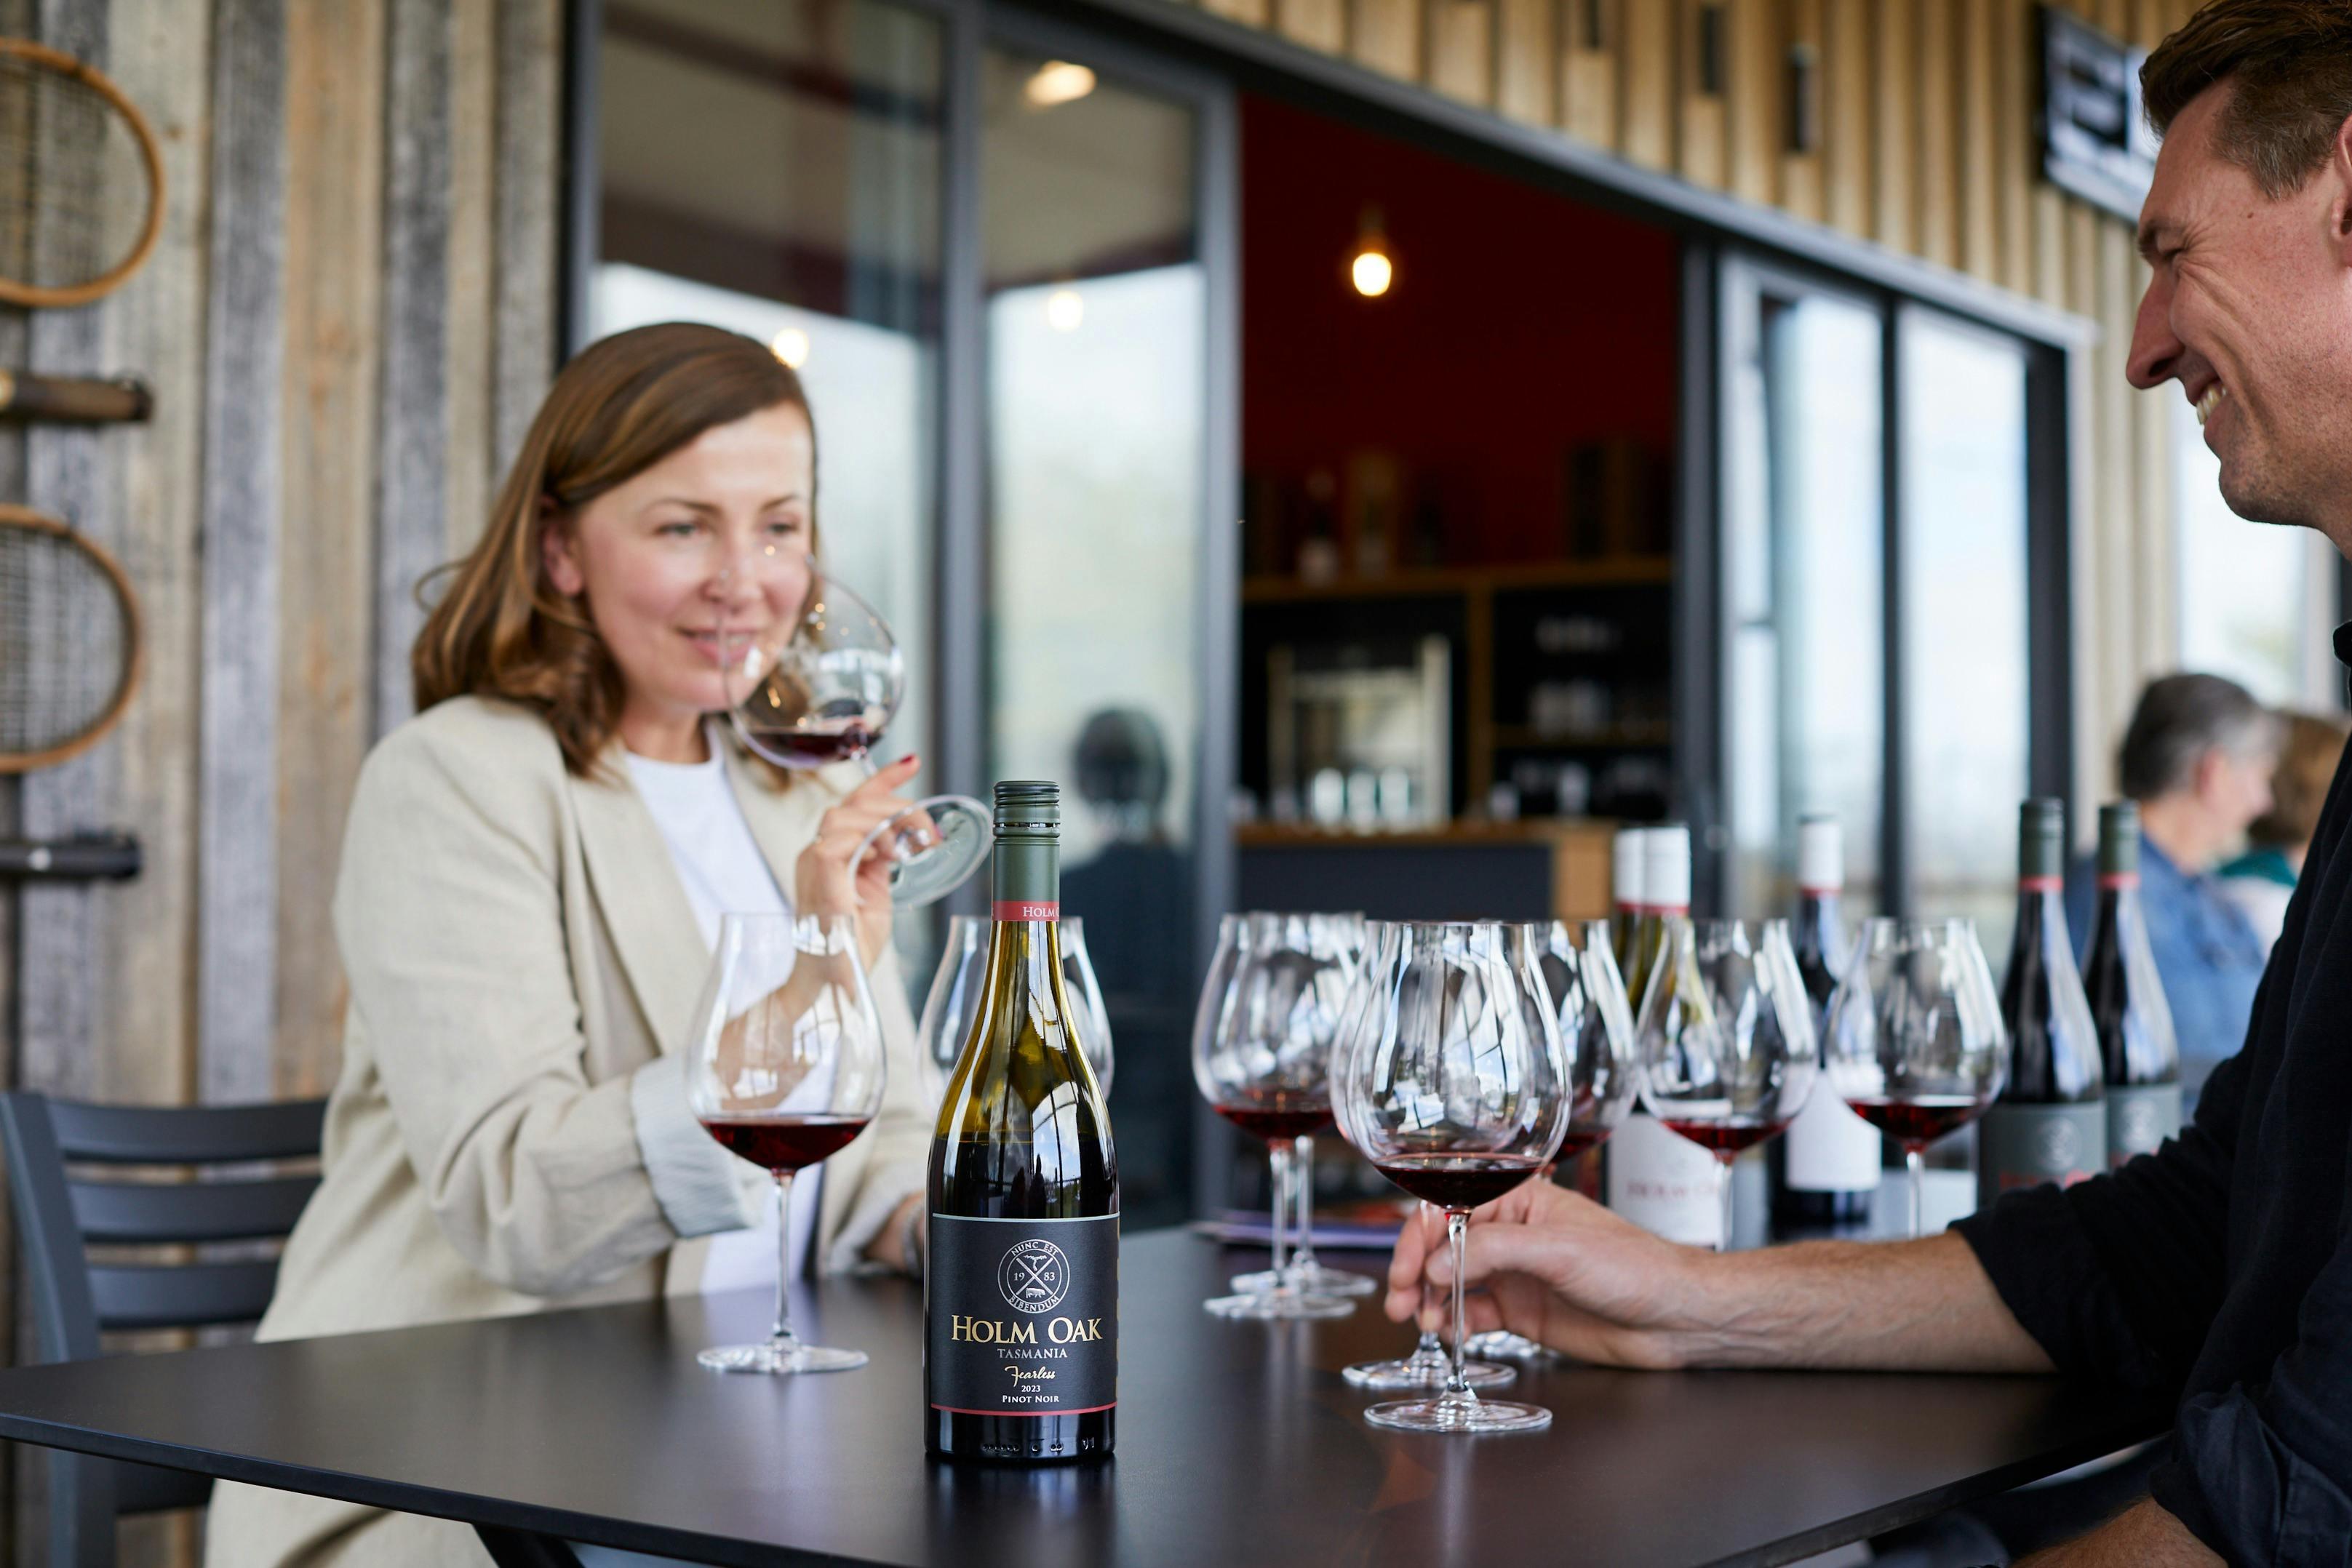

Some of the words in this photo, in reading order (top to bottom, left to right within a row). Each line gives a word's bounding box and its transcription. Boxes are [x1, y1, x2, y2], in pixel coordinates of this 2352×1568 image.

[1022, 906, 1055, 917] HOLM
[1010, 1241, 1039, 1256] NUNC
[1043, 1244, 1059, 1255] EST
[1013, 1272, 1025, 1281] 19
[1043, 1272, 1056, 1281] 83
[1008, 1295, 1059, 1312] BIBENDUM
[952, 1314, 1038, 1344] HOLM
[1048, 1317, 1103, 1344] OAK
[997, 1348, 1068, 1359] TASMANIA
[1005, 1366, 1056, 1387] Fearless
[1002, 1395, 1032, 1403] PINOT
[1035, 1395, 1059, 1403] NOIR
